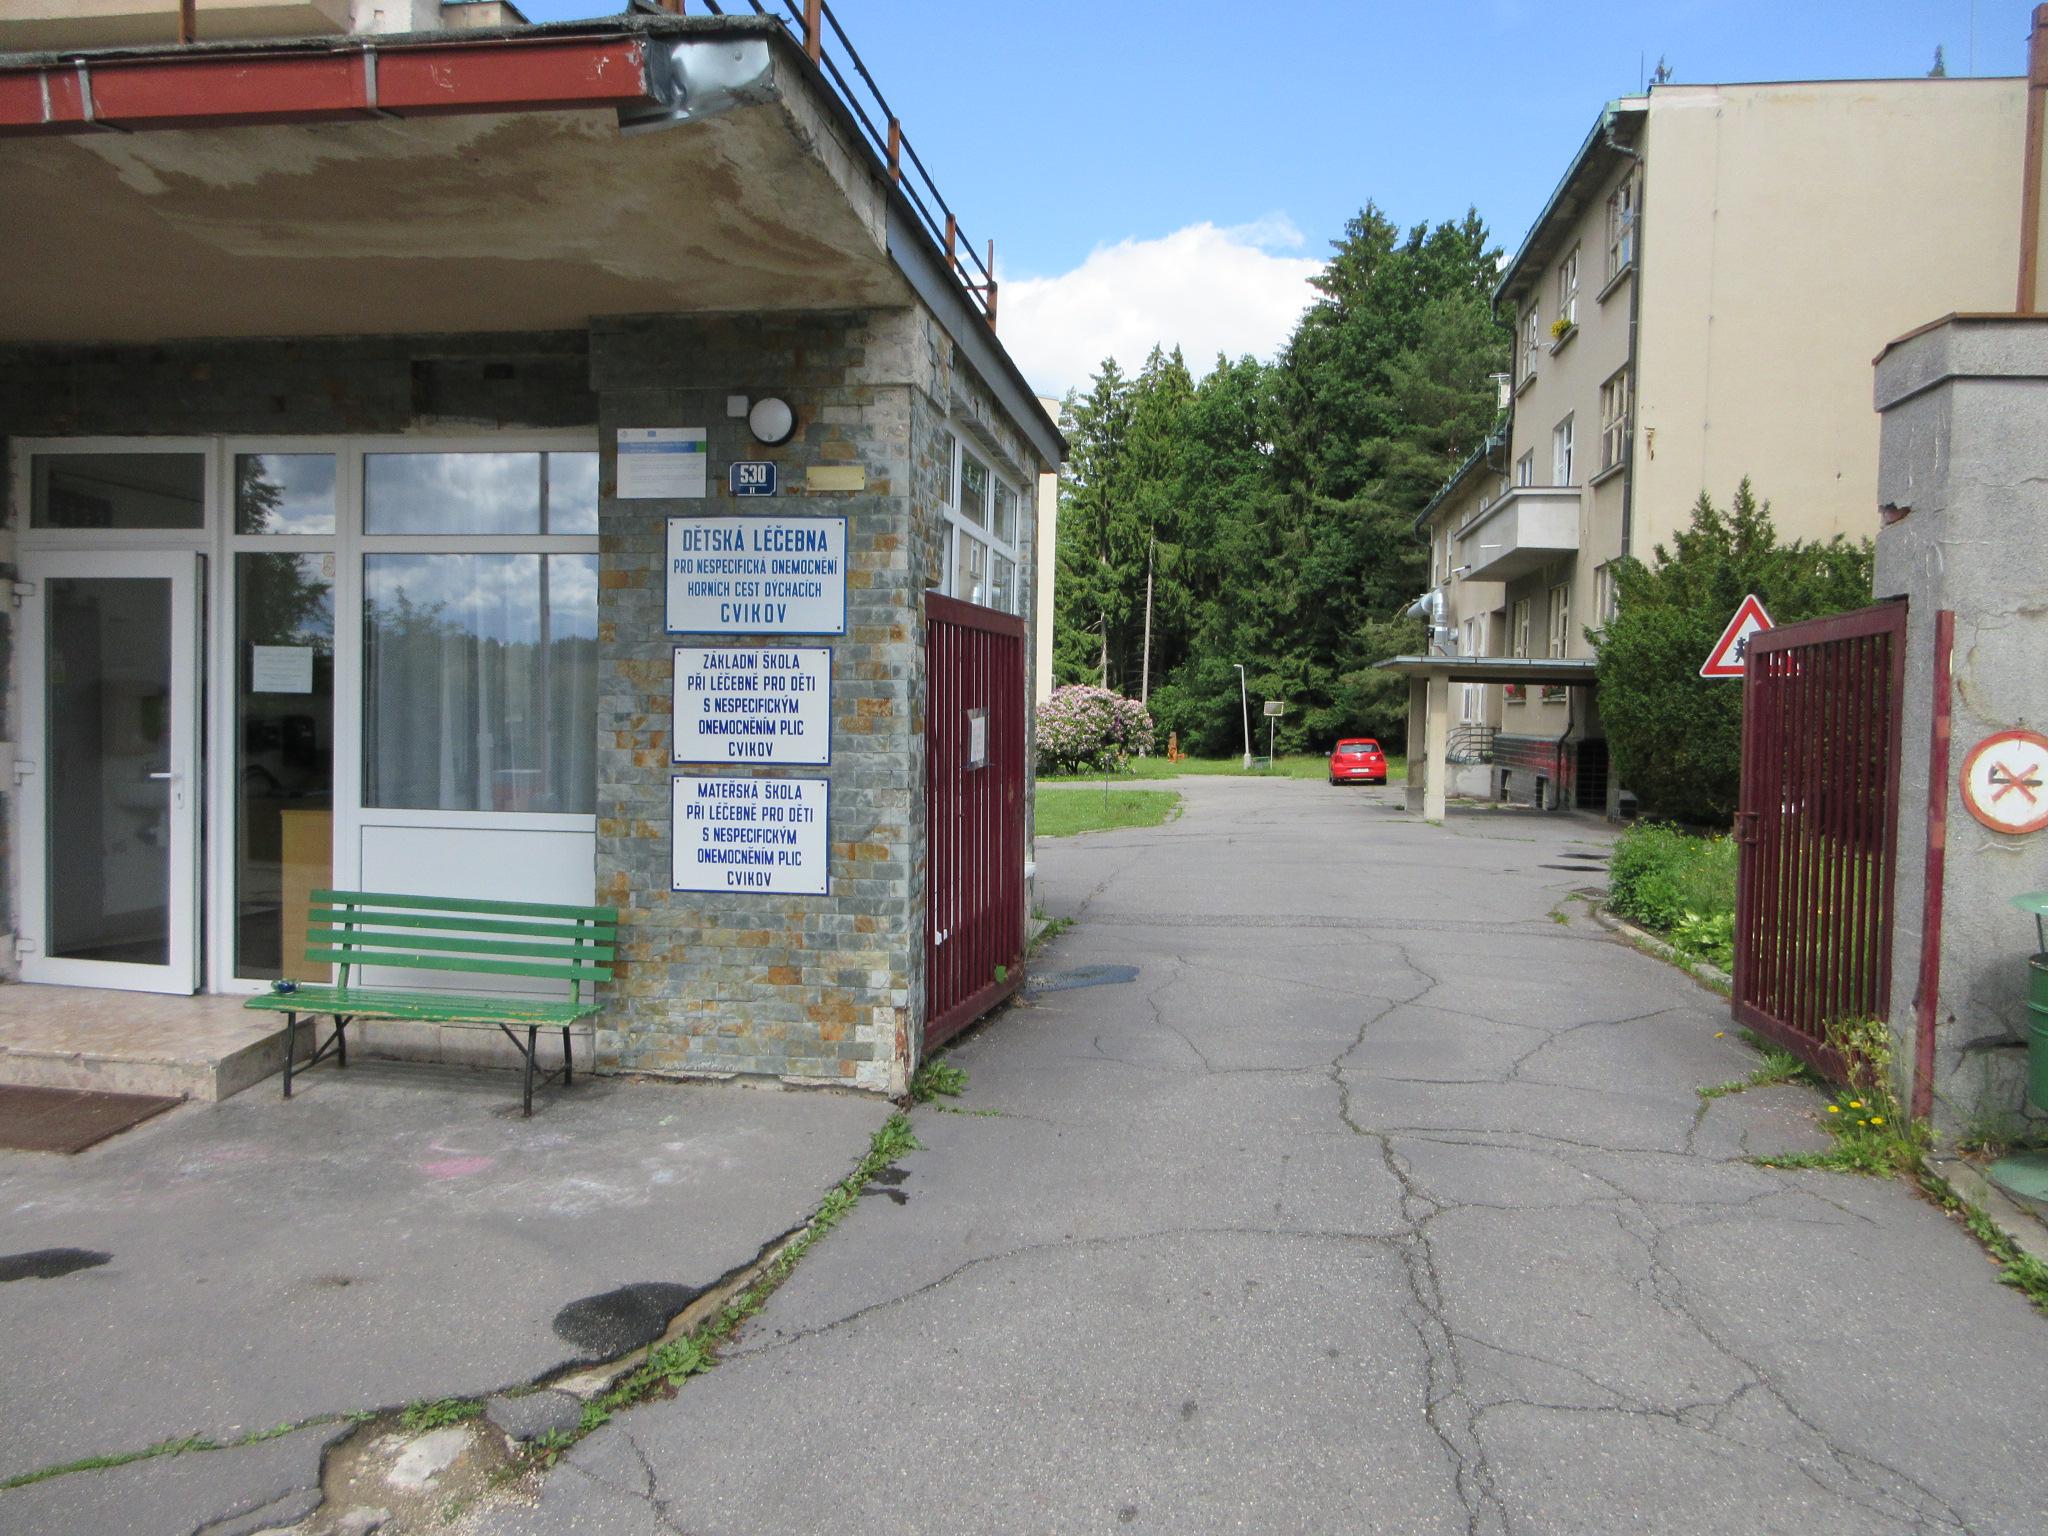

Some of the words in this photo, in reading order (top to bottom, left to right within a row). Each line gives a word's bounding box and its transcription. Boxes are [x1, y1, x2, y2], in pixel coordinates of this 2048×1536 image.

[740, 464, 767, 484] 530
[683, 525, 745, 551] DĚTSKÁ
[754, 525, 828, 552] LÉČEBNA
[674, 559, 693, 574] PRO
[697, 557, 766, 574] NESPECIFICKÁ
[772, 556, 838, 575] ONEMOCNĚNÍ
[688, 579, 730, 597] HORNÍCH
[735, 582, 759, 597] CEST
[765, 579, 822, 598] DÝCHACÍCH
[721, 604, 787, 623] CVIKOV
[703, 651, 758, 669] ZÁKLADNÍ
[763, 651, 800, 669] ŠKOLA
[688, 673, 705, 690] PŘI
[711, 673, 758, 691] LÉČEBNĚ
[764, 676, 785, 691] PRO
[791, 673, 815, 691] DĚTI
[704, 698, 710, 712] S
[715, 694, 799, 713] NESPECIFICKÝM
[699, 717, 776, 735] ONEMOCNĚNÍM
[781, 720, 804, 735] PLIC
[728, 742, 773, 757] CVIKOV
[698, 780, 758, 799] MATEŘSKÁ
[765, 781, 802, 800] ŠKOLA
[687, 802, 704, 819] PŘI
[710, 802, 757, 821] LÉČEBNĚ
[762, 807, 783, 822] PRO
[789, 804, 813, 822] DĚTI
[703, 827, 709, 841] S
[714, 826, 796, 844] NESPECIFICKÝM
[697, 847, 774, 865] ONEMOCNĚNÍM
[779, 851, 801, 866] PLIC
[728, 871, 771, 886] CVIKOV
